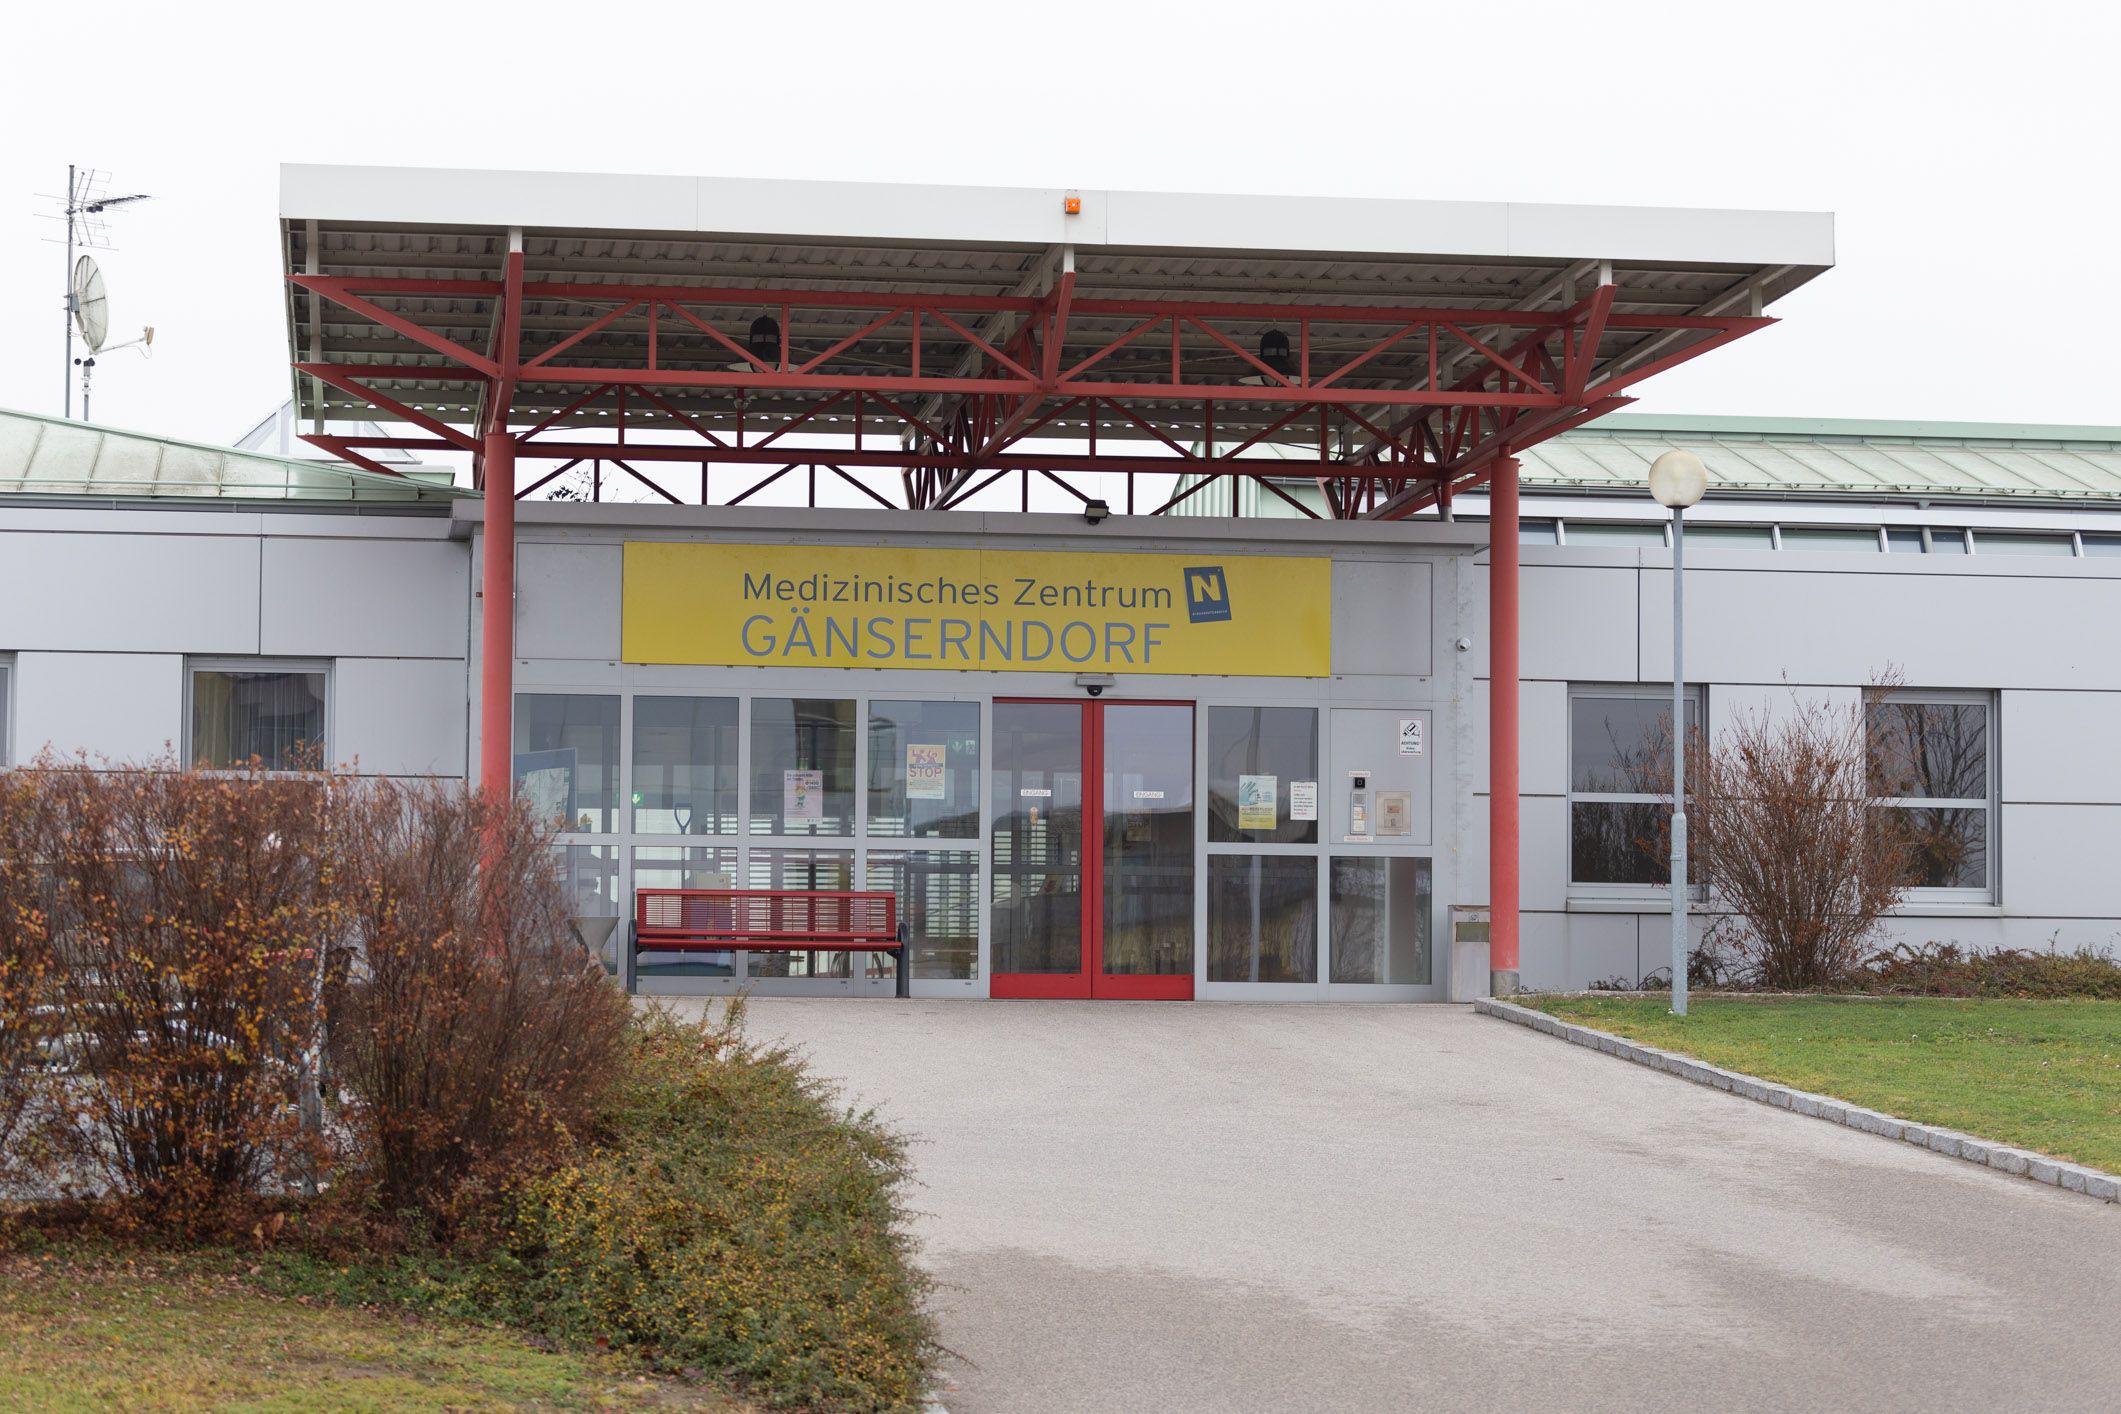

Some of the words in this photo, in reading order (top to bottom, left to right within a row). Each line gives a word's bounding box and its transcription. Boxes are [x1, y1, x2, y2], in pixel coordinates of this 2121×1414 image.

[744, 573, 999, 605] Medizinisches
[1013, 578, 1172, 609] Zentrum
[1191, 574, 1222, 603] N
[741, 606, 1171, 664] GÄNSERNDORF
[909, 768, 942, 778] STOP
